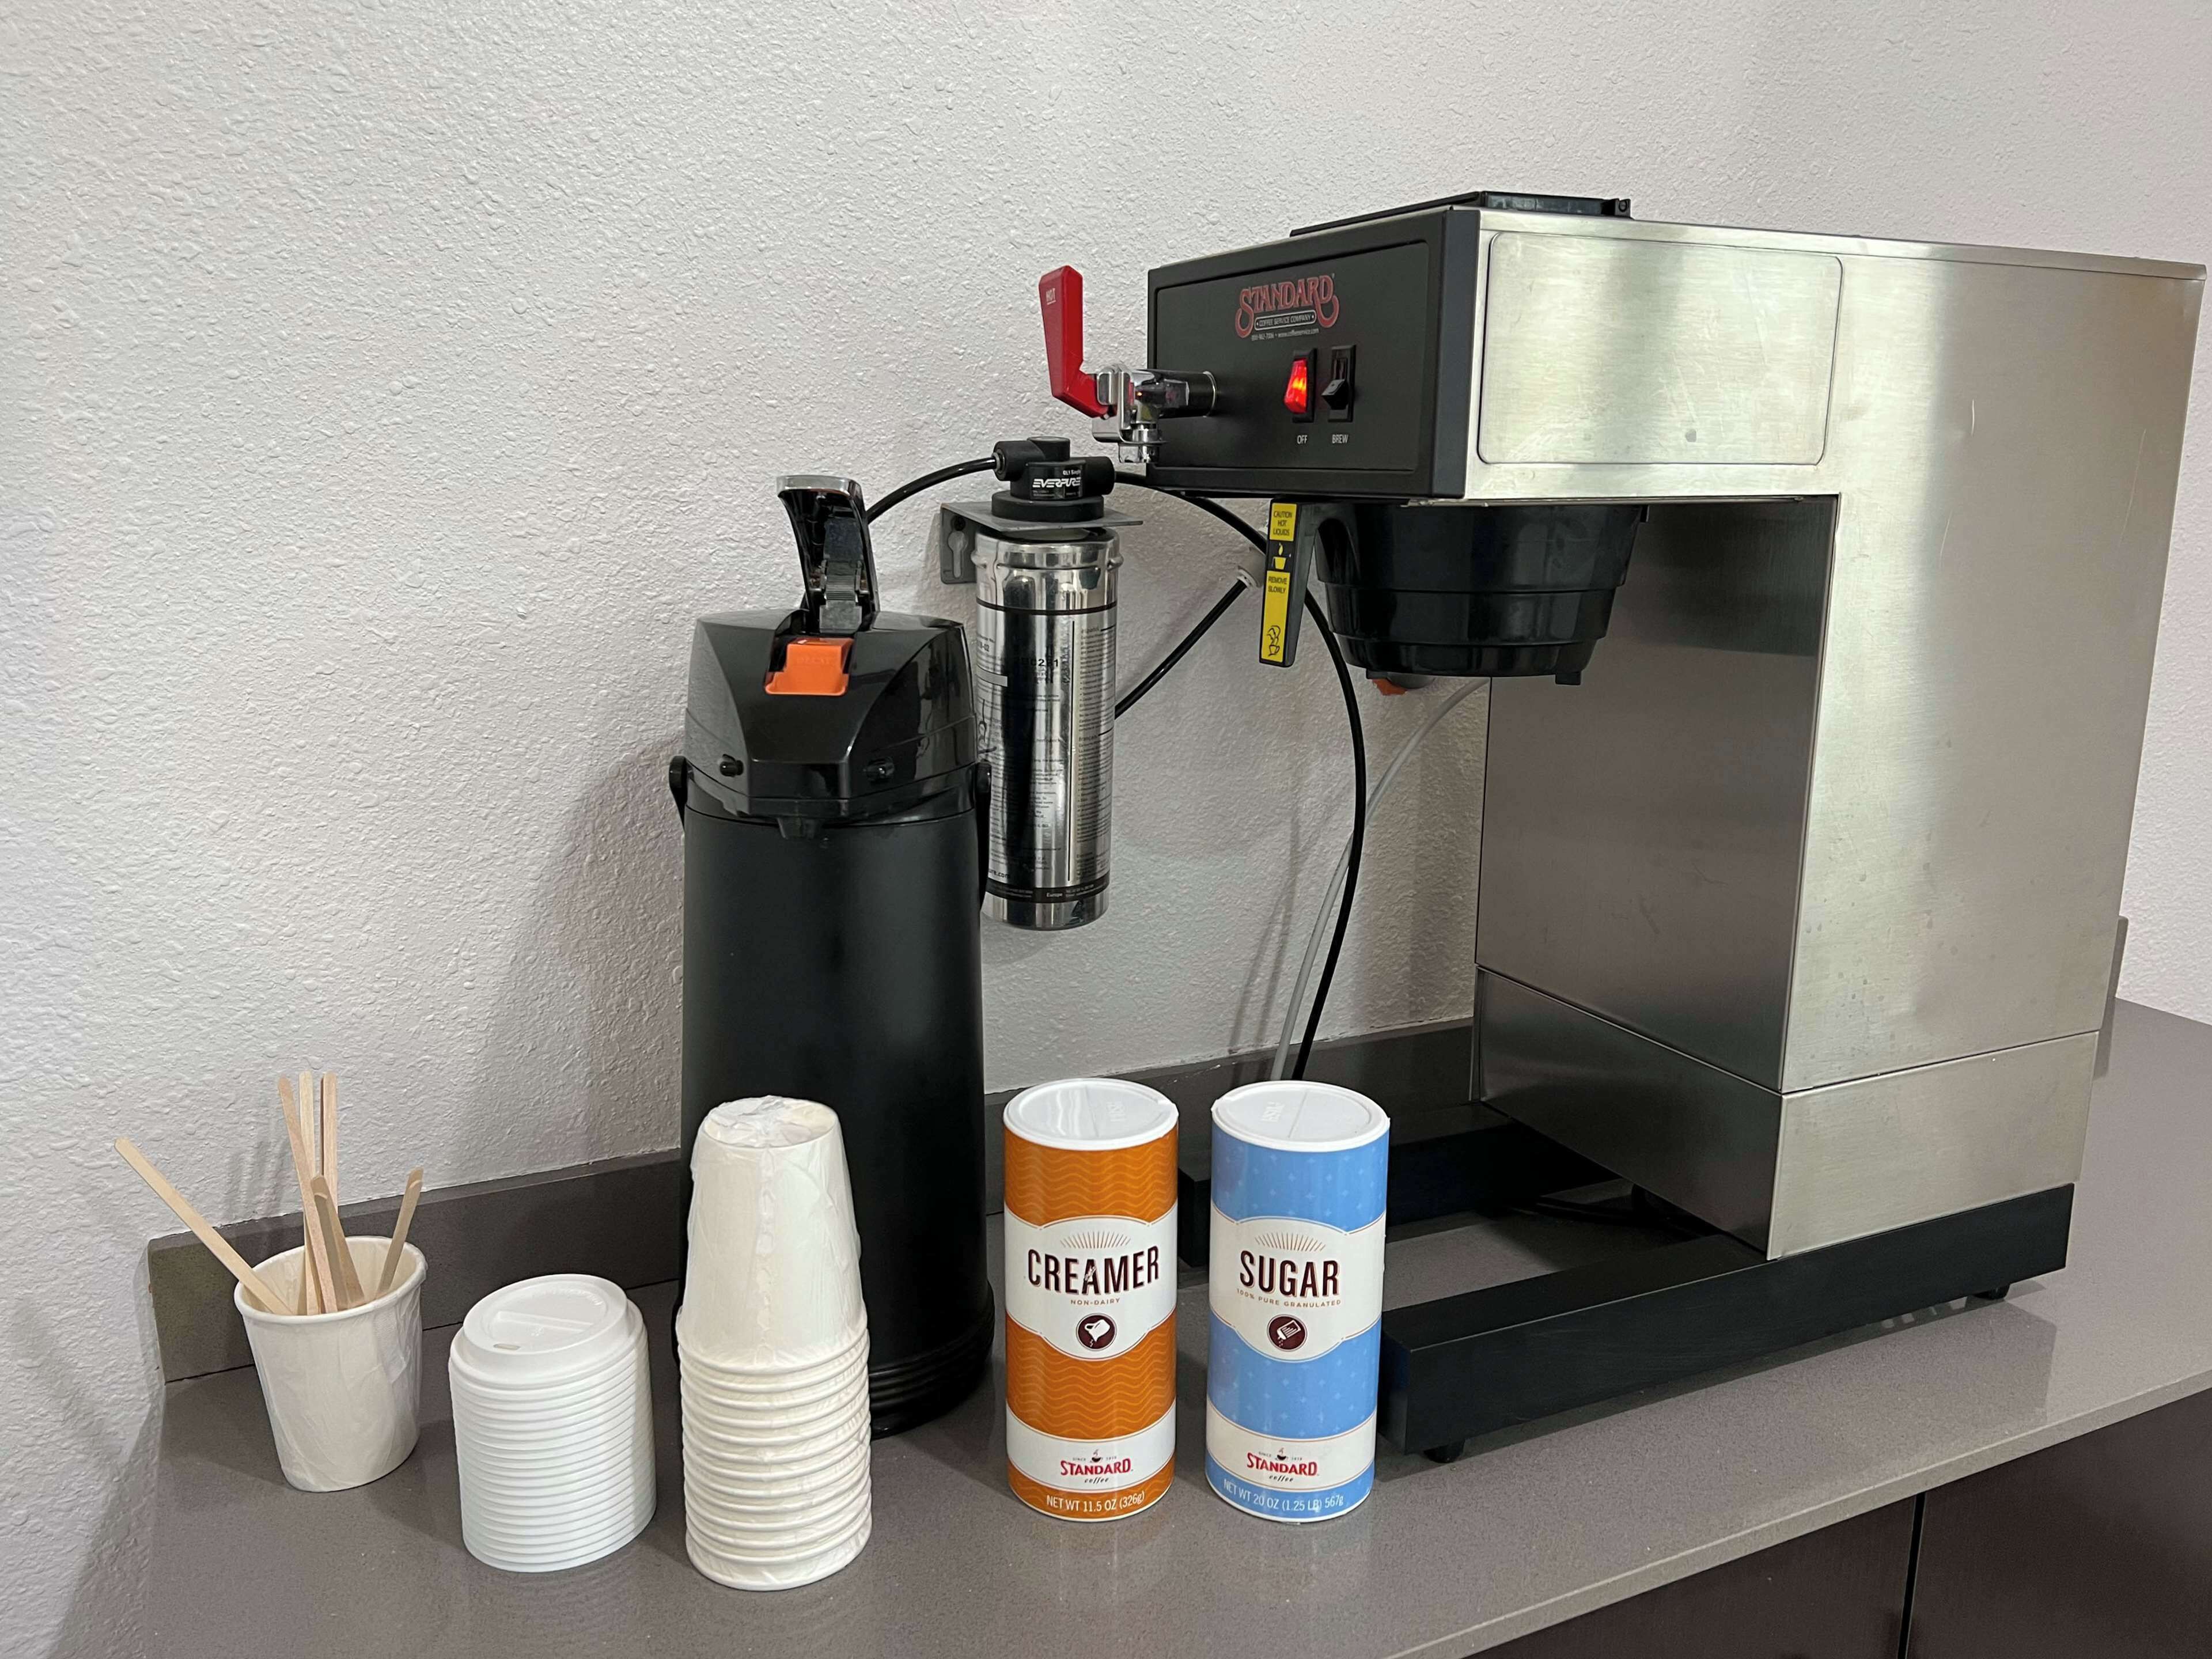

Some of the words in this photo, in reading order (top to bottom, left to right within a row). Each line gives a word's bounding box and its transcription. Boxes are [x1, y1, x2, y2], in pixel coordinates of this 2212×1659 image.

[1235, 275, 1339, 338] STANDARD
[1297, 435, 1308, 444] OFF
[1332, 434, 1349, 444] BREW
[1032, 477, 1081, 488] EVERPURE
[1273, 528, 1290, 536] LIQUIDS
[1268, 576, 1287, 585] REMOVE
[1268, 585, 1286, 593] SLOWLY
[1028, 1245, 1159, 1295] CREAMER
[1240, 1250, 1340, 1298] SUGAR
[1070, 1298, 1120, 1306] NON-DAIRY
[1237, 1288, 1255, 1300] 100%
[1258, 1296, 1279, 1305] PURE
[1283, 1300, 1342, 1308] GRANULATED
[1060, 1458, 1131, 1476] STANDARD
[1247, 1452, 1317, 1476] STANDARD
[1046, 1495, 1063, 1509] NET
[1065, 1500, 1080, 1512] WT
[1083, 1501, 1102, 1512] 11.5
[1104, 1499, 1116, 1510] OZ
[1119, 1490, 1145, 1509] (326g)
[1223, 1479, 1237, 1495] NET
[1238, 1487, 1251, 1502] WT
[1253, 1494, 1264, 1506] 20
[1267, 1497, 1279, 1509] OZ
[1282, 1499, 1305, 1512] (1.25
[1308, 1499, 1323, 1511] LB)
[1324, 1495, 1344, 1509] 567g
